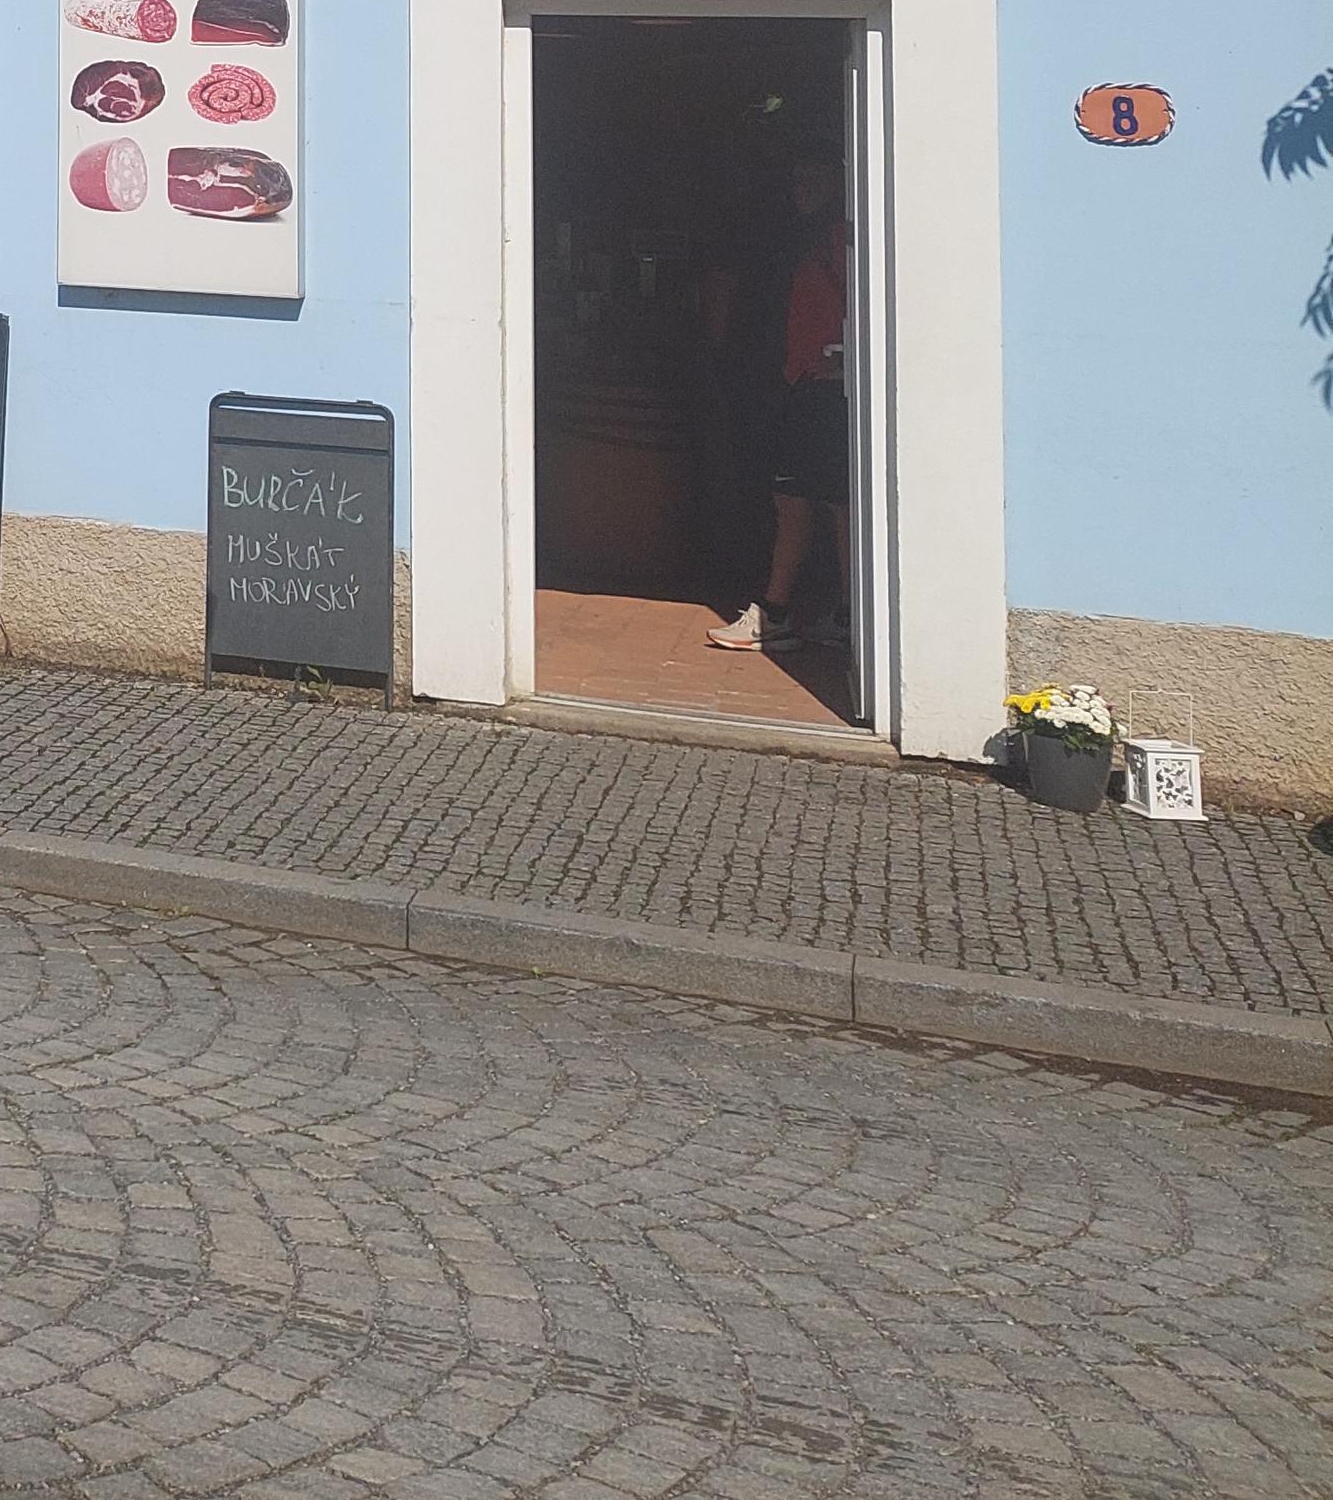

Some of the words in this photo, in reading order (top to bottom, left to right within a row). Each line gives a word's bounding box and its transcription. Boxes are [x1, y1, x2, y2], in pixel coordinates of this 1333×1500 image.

[1113, 96, 1138, 136] 8
[221, 466, 364, 524] BURČÁK
[227, 533, 345, 571] MUŠKÁT
[230, 574, 360, 612] MORAVSKÝ
